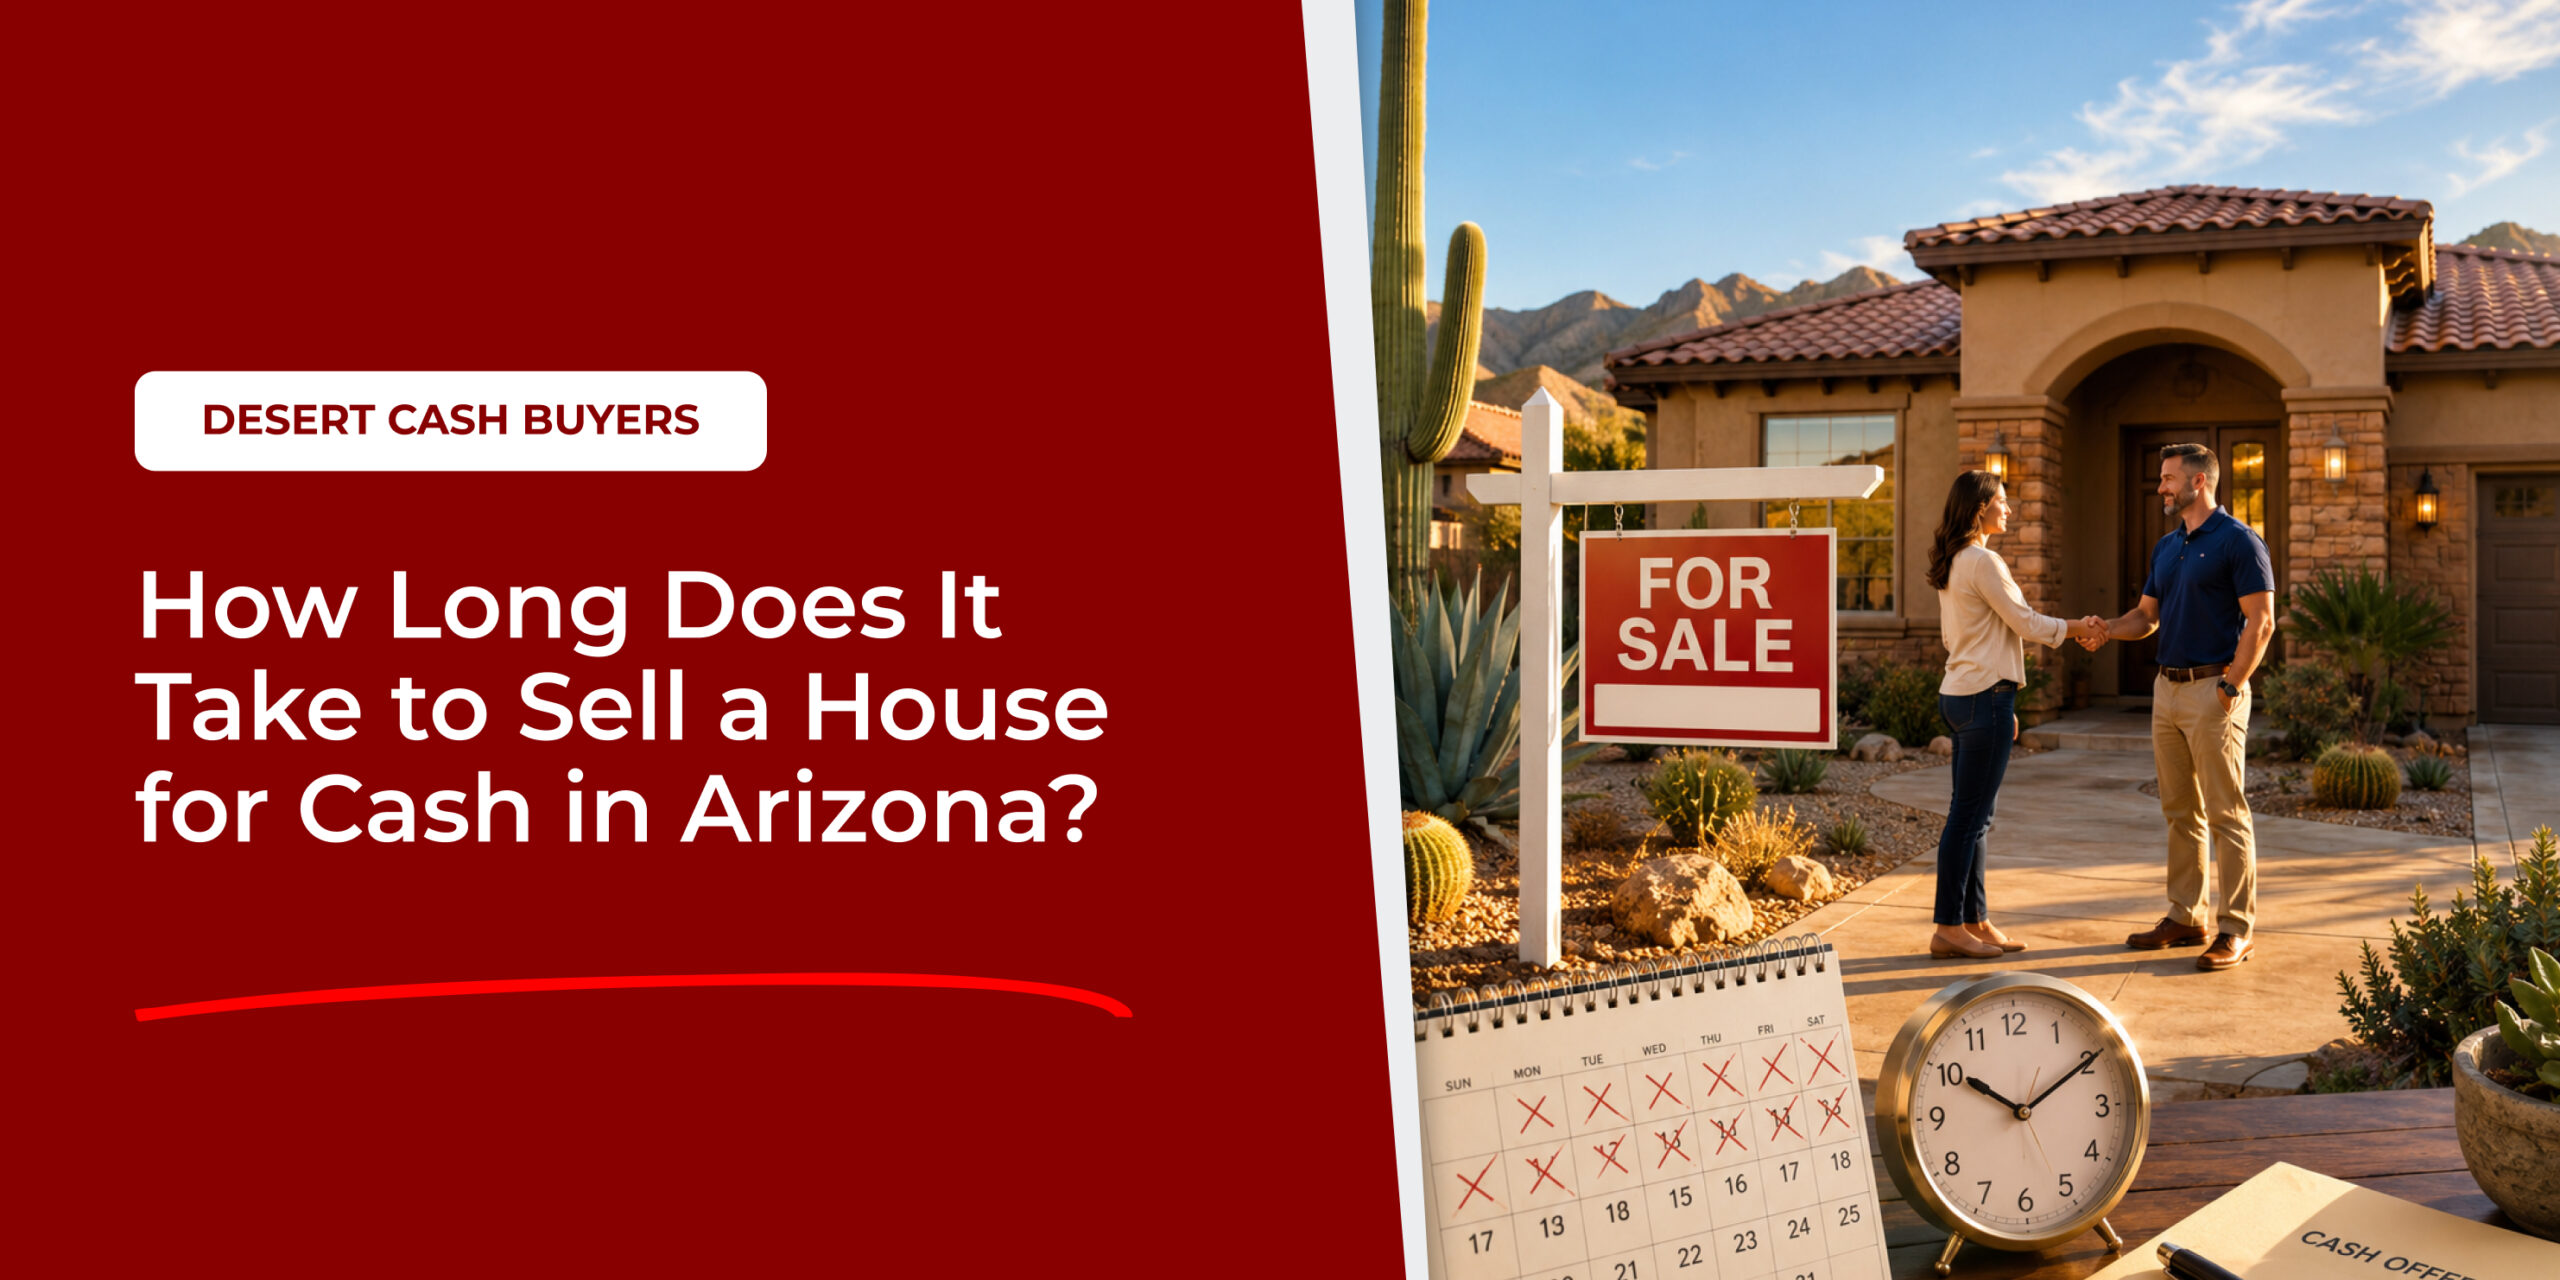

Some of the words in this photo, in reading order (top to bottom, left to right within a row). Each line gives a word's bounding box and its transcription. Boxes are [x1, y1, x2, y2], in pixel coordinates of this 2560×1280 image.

[1639, 556, 1773, 610] FOR
[1617, 617, 1794, 672] SALE
[2001, 1012, 2026, 1036] 12
[2051, 1020, 2060, 1044] 1
[1965, 1027, 1985, 1051] 11
[1445, 1078, 1471, 1092] SUN
[1514, 1065, 1541, 1079] MON
[1582, 1054, 1604, 1067] TUE
[1642, 1043, 1667, 1057] WED
[1701, 1034, 1721, 1046] THU
[1758, 1024, 1774, 1036] FRI
[1807, 1015, 1825, 1027] SAT
[2080, 1050, 2096, 1075] 2
[1937, 1062, 1963, 1086] 10
[2095, 1094, 2110, 1118] 3
[1929, 1106, 1945, 1131] 9
[2084, 1139, 2100, 1162] 4
[1945, 1151, 1960, 1176] 8
[1977, 1181, 1992, 1205] 7
[2058, 1173, 2074, 1197] 5
[1468, 1230, 1493, 1254] 17
[1539, 1215, 1565, 1238] 13
[1606, 1201, 1630, 1223] 18
[1669, 1185, 1693, 1209] 15
[1725, 1174, 1748, 1195] 16
[1780, 1161, 1799, 1183] 17
[1830, 1150, 1851, 1171] 18
[2017, 1188, 2034, 1212] 6
[1614, 1260, 1638, 1280] 21
[1678, 1244, 1703, 1268] 22
[1733, 1230, 1757, 1253] 23
[1787, 1217, 1811, 1239] 24
[1838, 1204, 1860, 1226] 25
[2301, 1231, 2382, 1263] CASH
[2383, 1256, 2477, 1280] OFFE
